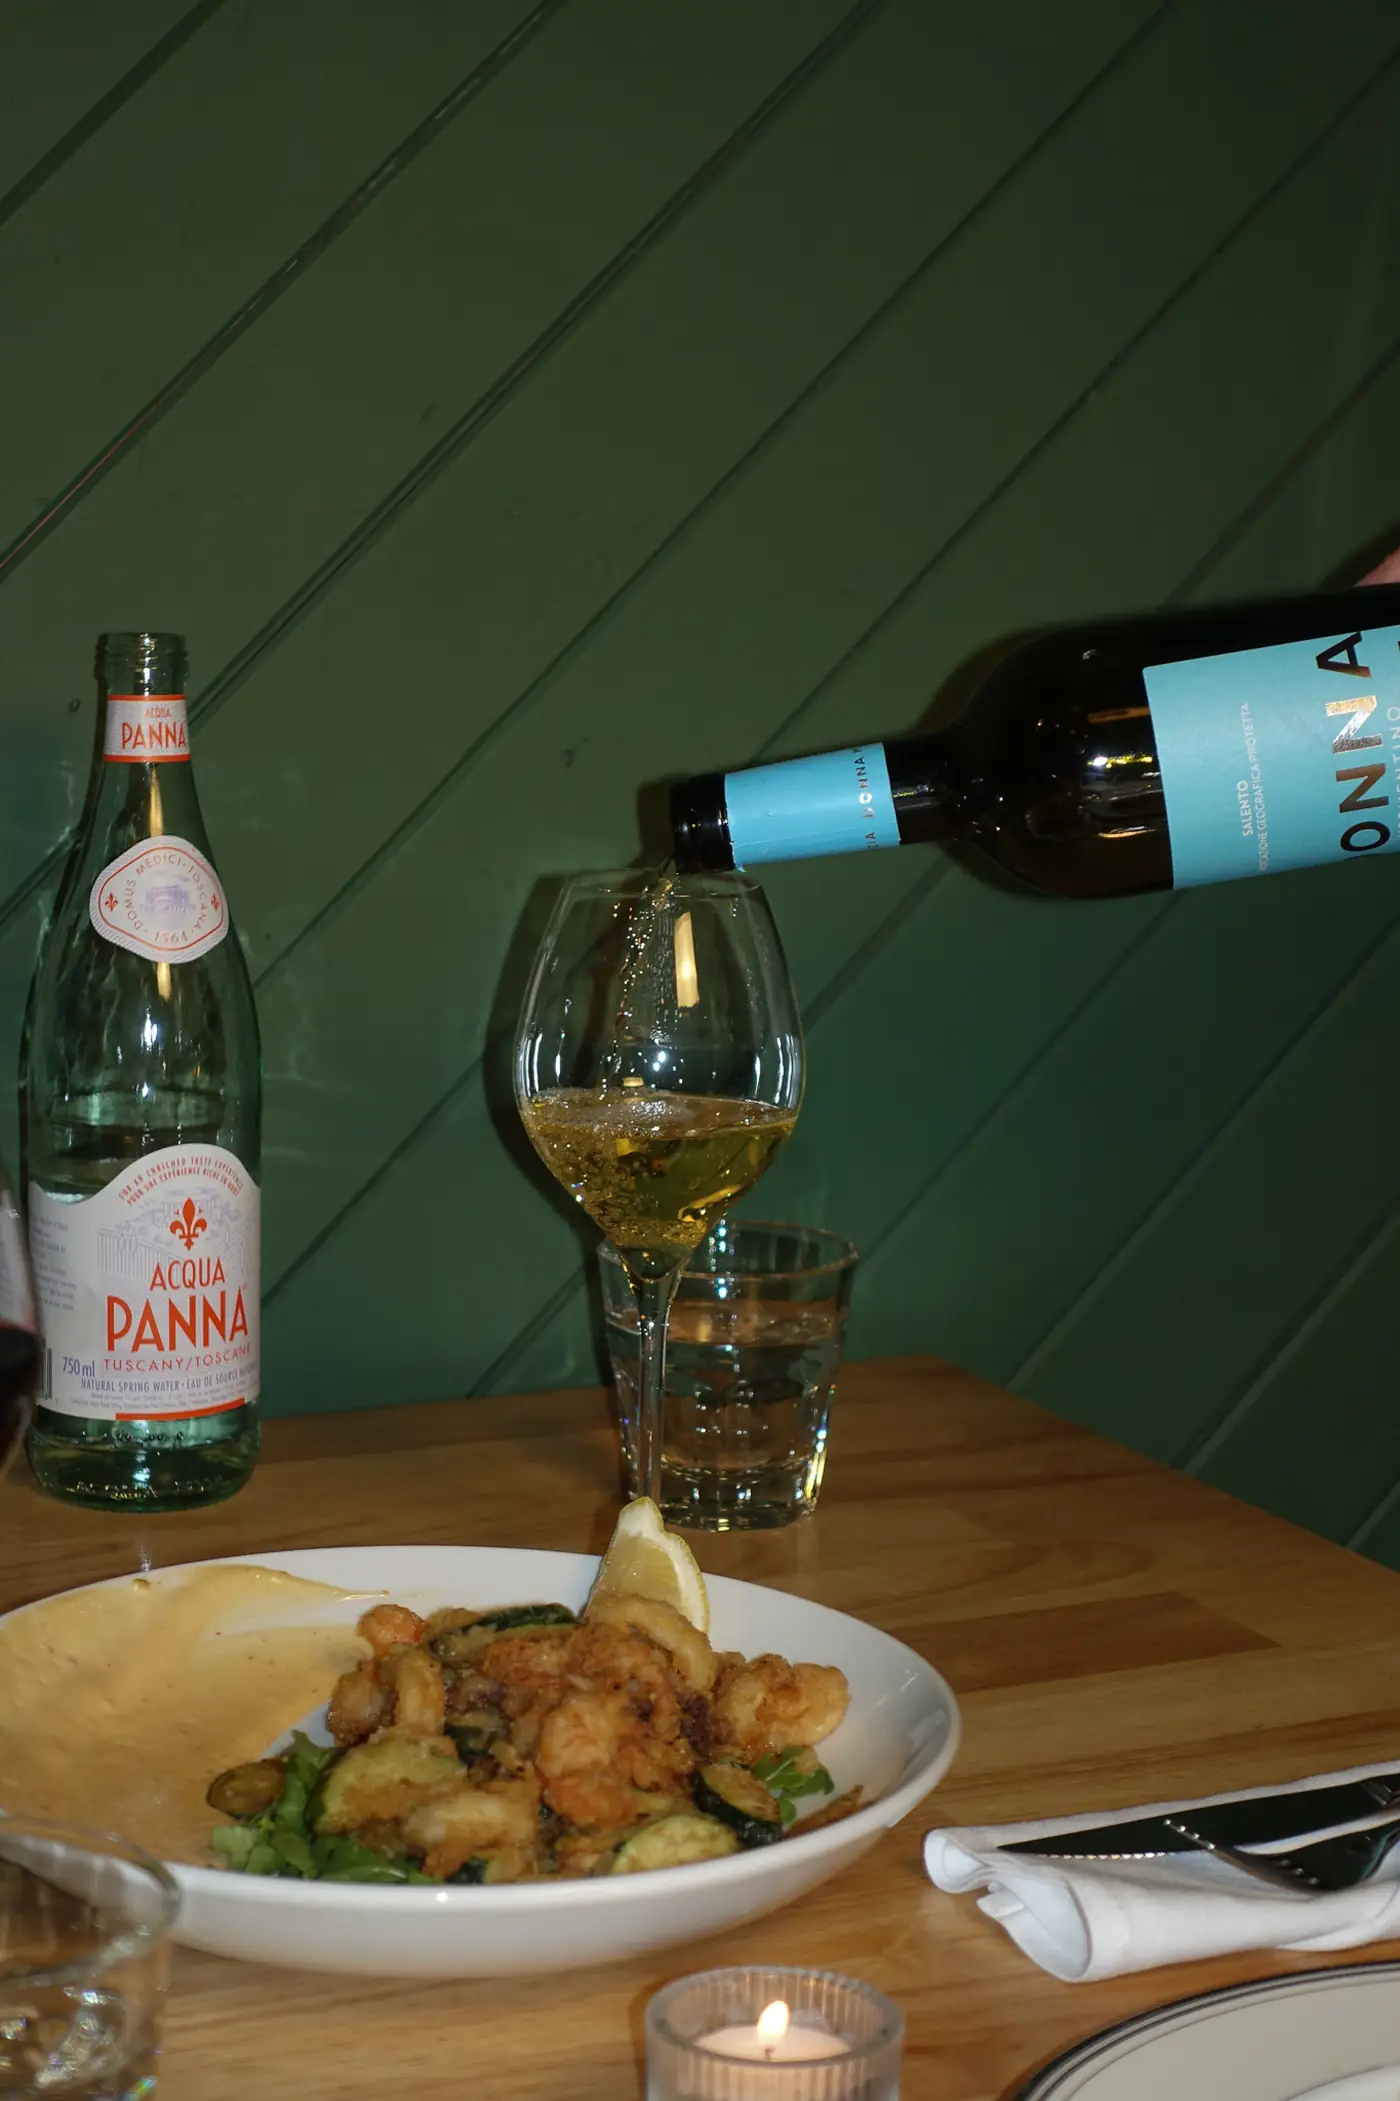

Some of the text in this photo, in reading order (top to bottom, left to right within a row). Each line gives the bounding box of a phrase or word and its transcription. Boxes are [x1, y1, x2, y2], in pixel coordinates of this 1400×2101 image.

[144, 706, 171, 718] ACQUA
[1240, 702, 1257, 761] PROTETTA
[121, 721, 186, 750] PANNA
[1236, 780, 1253, 837] SALENTO
[1250, 763, 1267, 830] GEOGRAFICA
[124, 878, 143, 931] DOMUS
[136, 854, 182, 875] MEDICI
[188, 866, 208, 929] TOSCANA
[149, 1257, 226, 1291] ACQUA
[106, 1288, 248, 1353] PANNA
[62, 1356, 95, 1377] 750 ml
[81, 1379, 116, 1393] NATURAL
[118, 1380, 149, 1393] SPRING
[153, 1380, 180, 1392] WATER
[186, 1376, 201, 1389] EAU
[204, 1375, 213, 1387] DE
